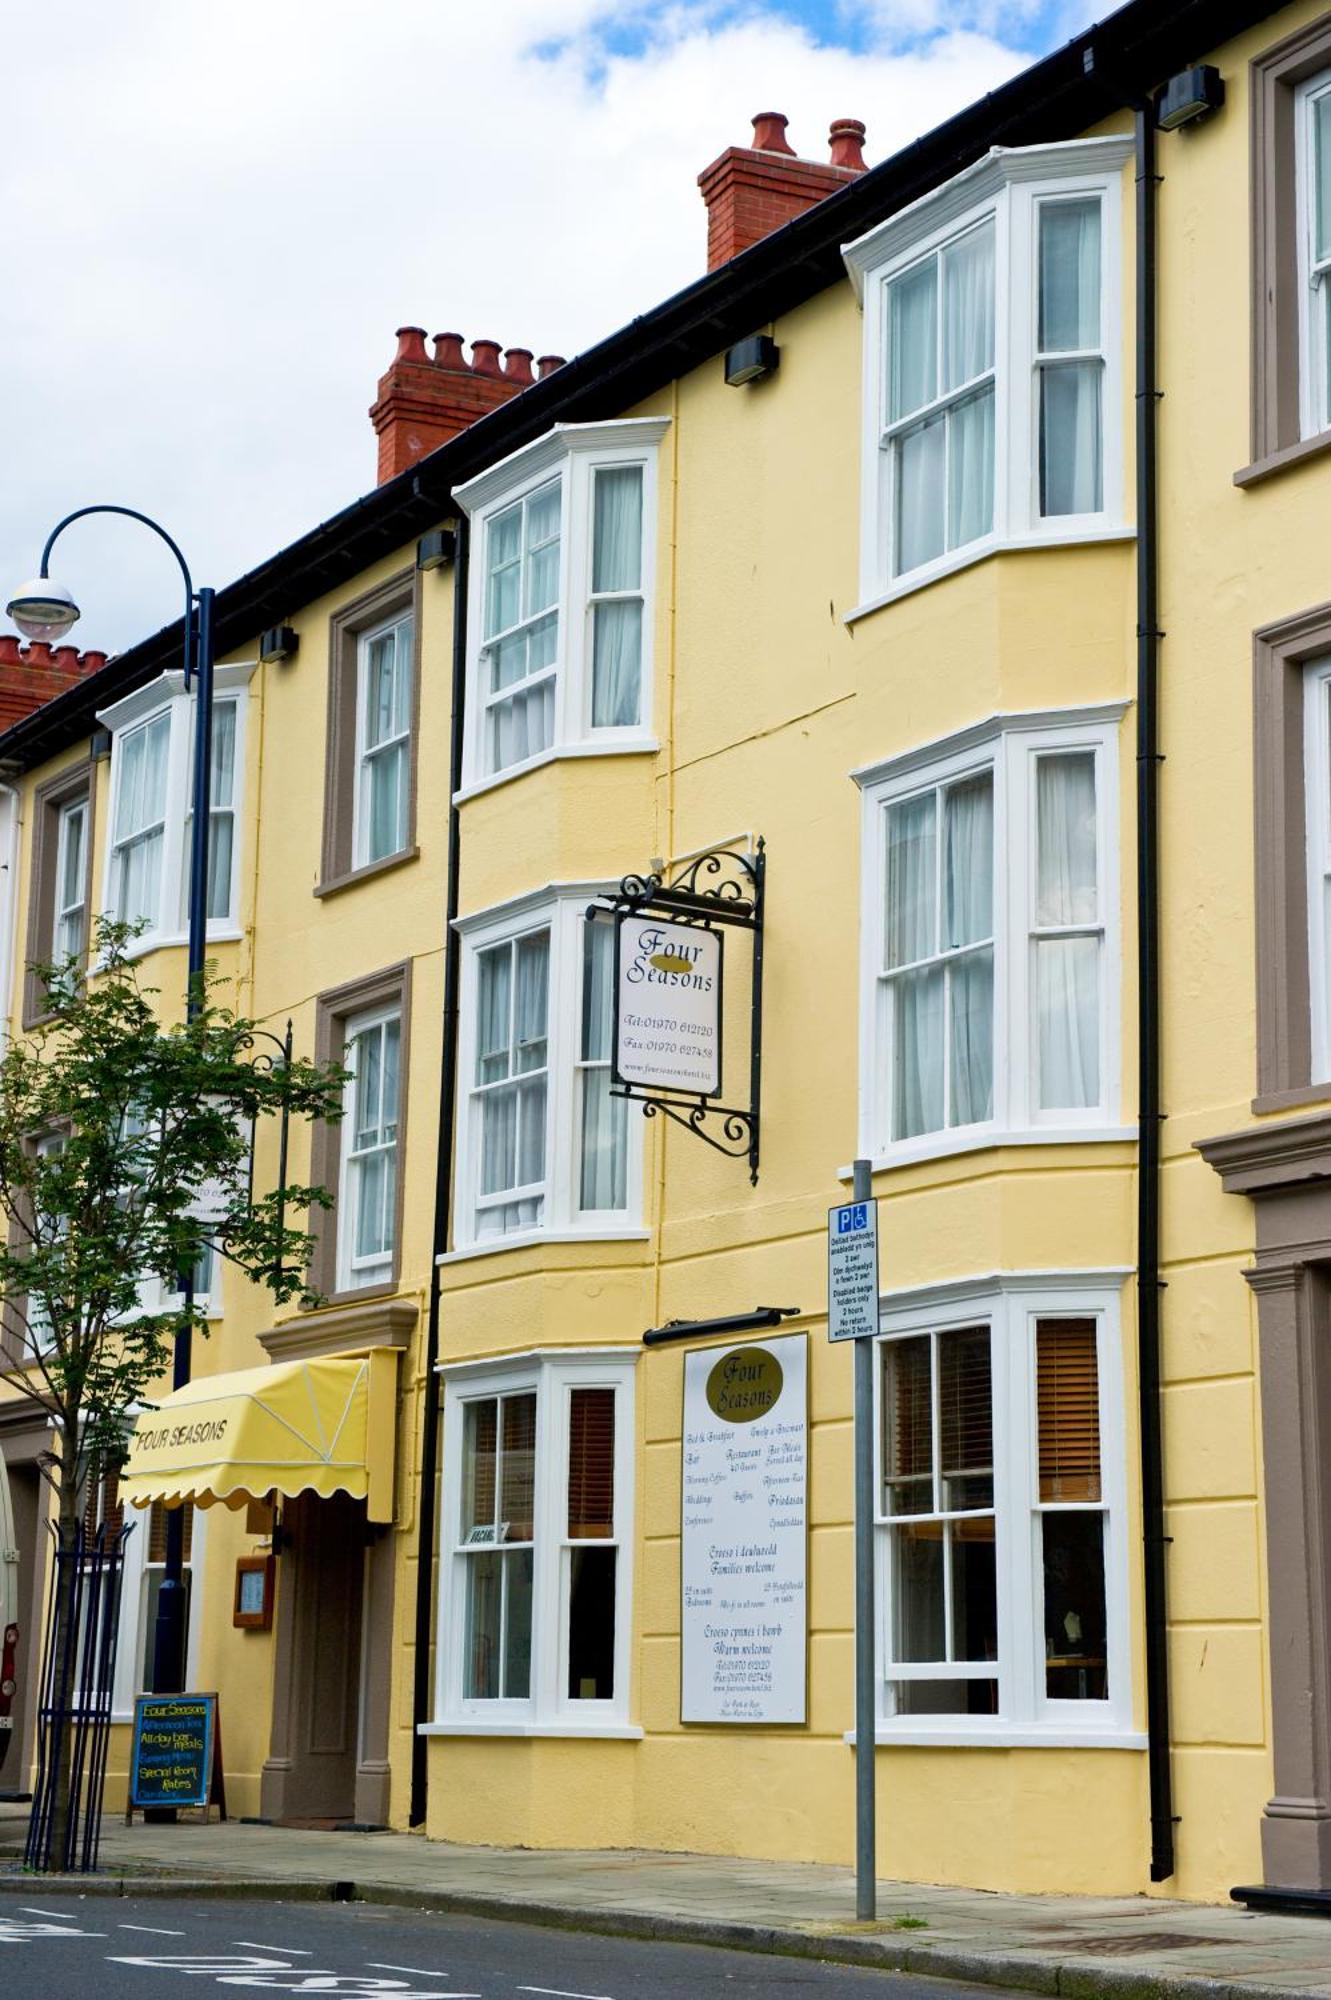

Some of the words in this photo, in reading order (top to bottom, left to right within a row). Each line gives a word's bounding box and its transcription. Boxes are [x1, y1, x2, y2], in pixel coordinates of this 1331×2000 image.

[638, 928, 703, 962] Four
[626, 955, 712, 991] Seasons
[679, 1022, 713, 1038] 612120
[841, 1211, 850, 1232] P
[833, 1286, 856, 1298] Disabled
[857, 1285, 873, 1294] badge
[837, 1296, 857, 1306] holders
[858, 1294, 870, 1303] only
[847, 1306, 864, 1315] hours
[840, 1319, 848, 1327] No
[849, 1316, 867, 1325] return
[834, 1327, 851, 1337] within
[857, 1324, 873, 1333] hours
[723, 1356, 766, 1384] Four
[717, 1385, 773, 1413] Seasons
[135, 1429, 170, 1452] FOUR
[169, 1419, 228, 1447] SEASONS
[726, 1448, 761, 1461] Restaurant
[709, 1545, 734, 1560] Croeso
[711, 1561, 743, 1576] Families
[745, 1561, 776, 1574] welcome
[704, 1624, 729, 1638] Croeso
[713, 1641, 740, 1655] Warm
[742, 1643, 772, 1655] welcome
[143, 1704, 168, 1717] Four
[174, 1738, 204, 1751] meals
